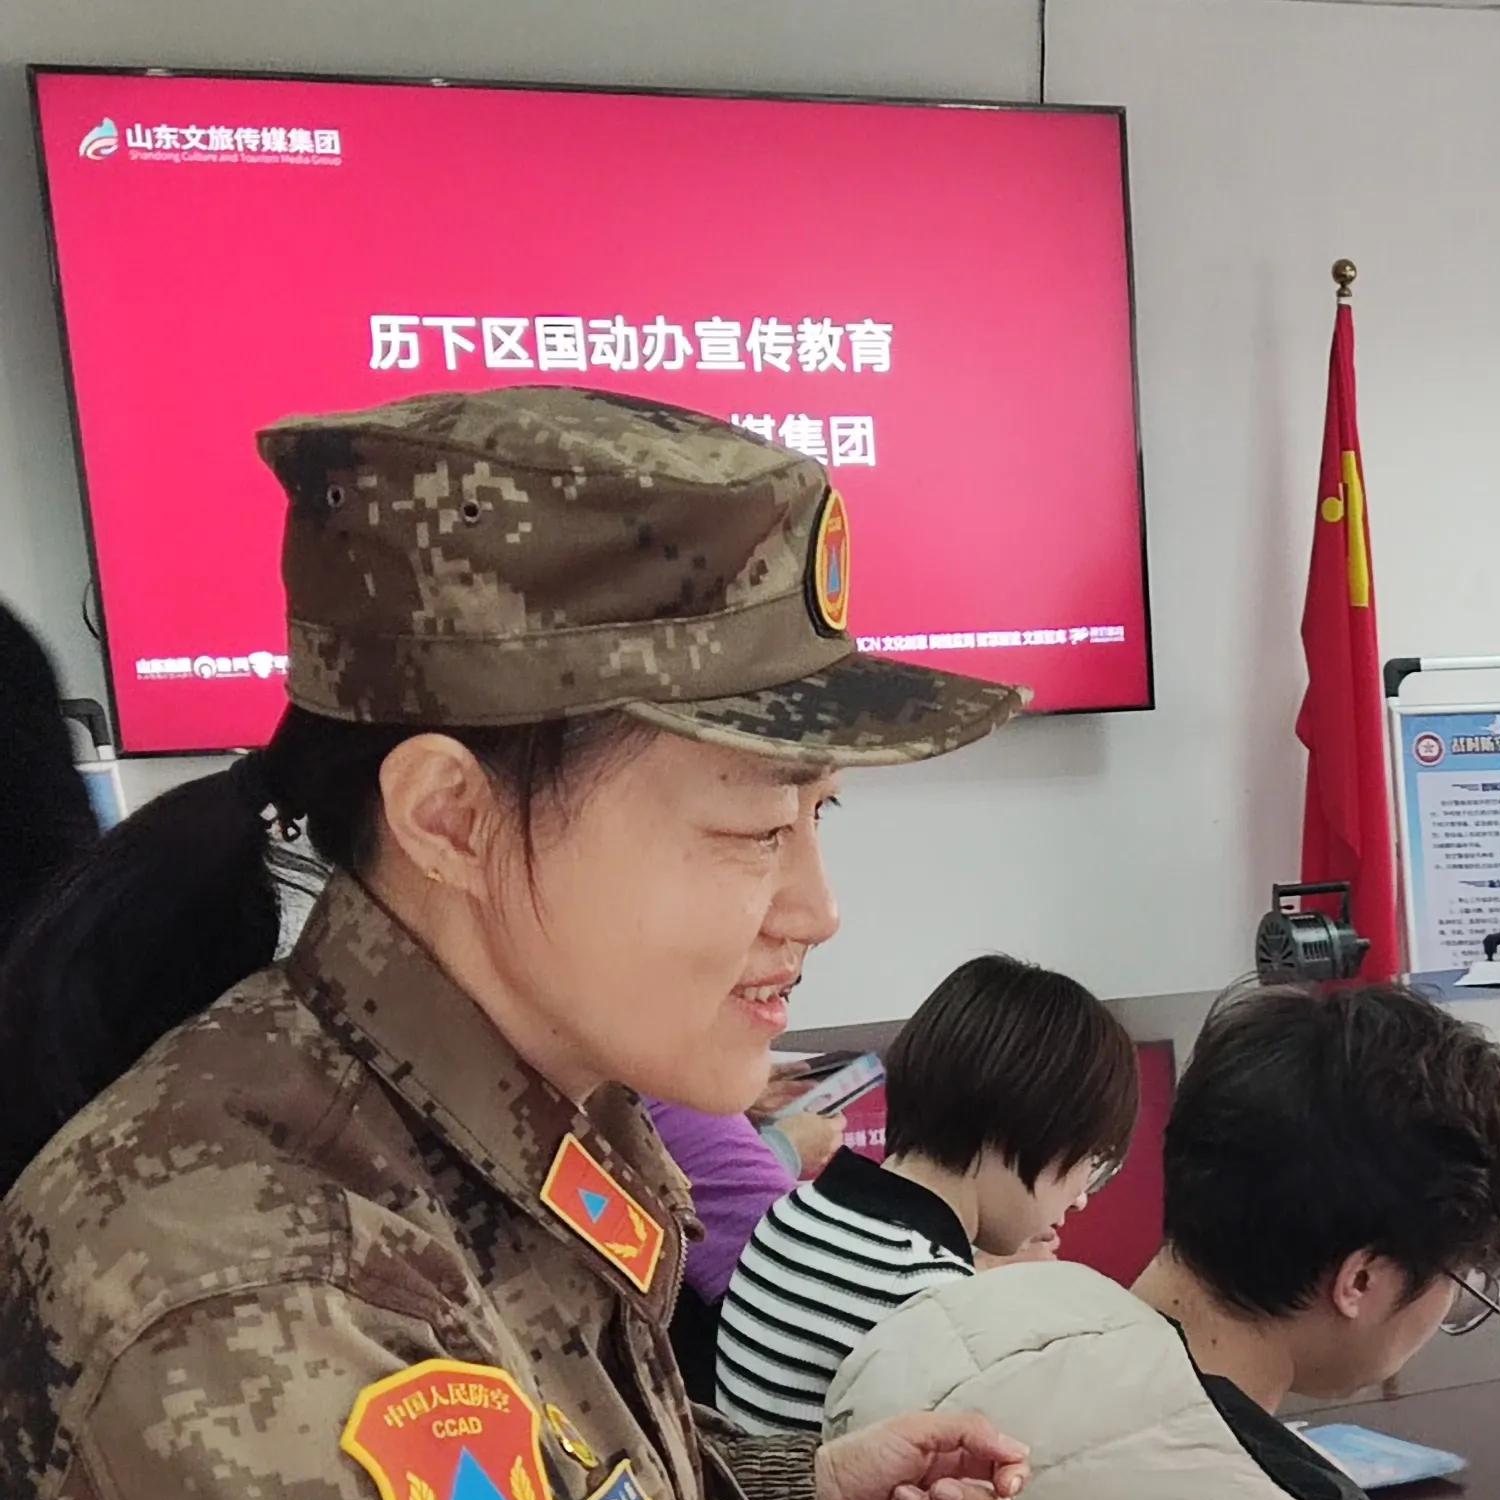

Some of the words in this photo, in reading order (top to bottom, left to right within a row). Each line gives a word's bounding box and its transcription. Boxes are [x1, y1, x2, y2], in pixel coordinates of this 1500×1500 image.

[126, 124, 341, 155] 山东文旅传媒集团
[369, 315, 893, 373] 历下区国动办宣传教育
[384, 1383, 511, 1428] 中国人民防空
[432, 1416, 483, 1439] CCAD
